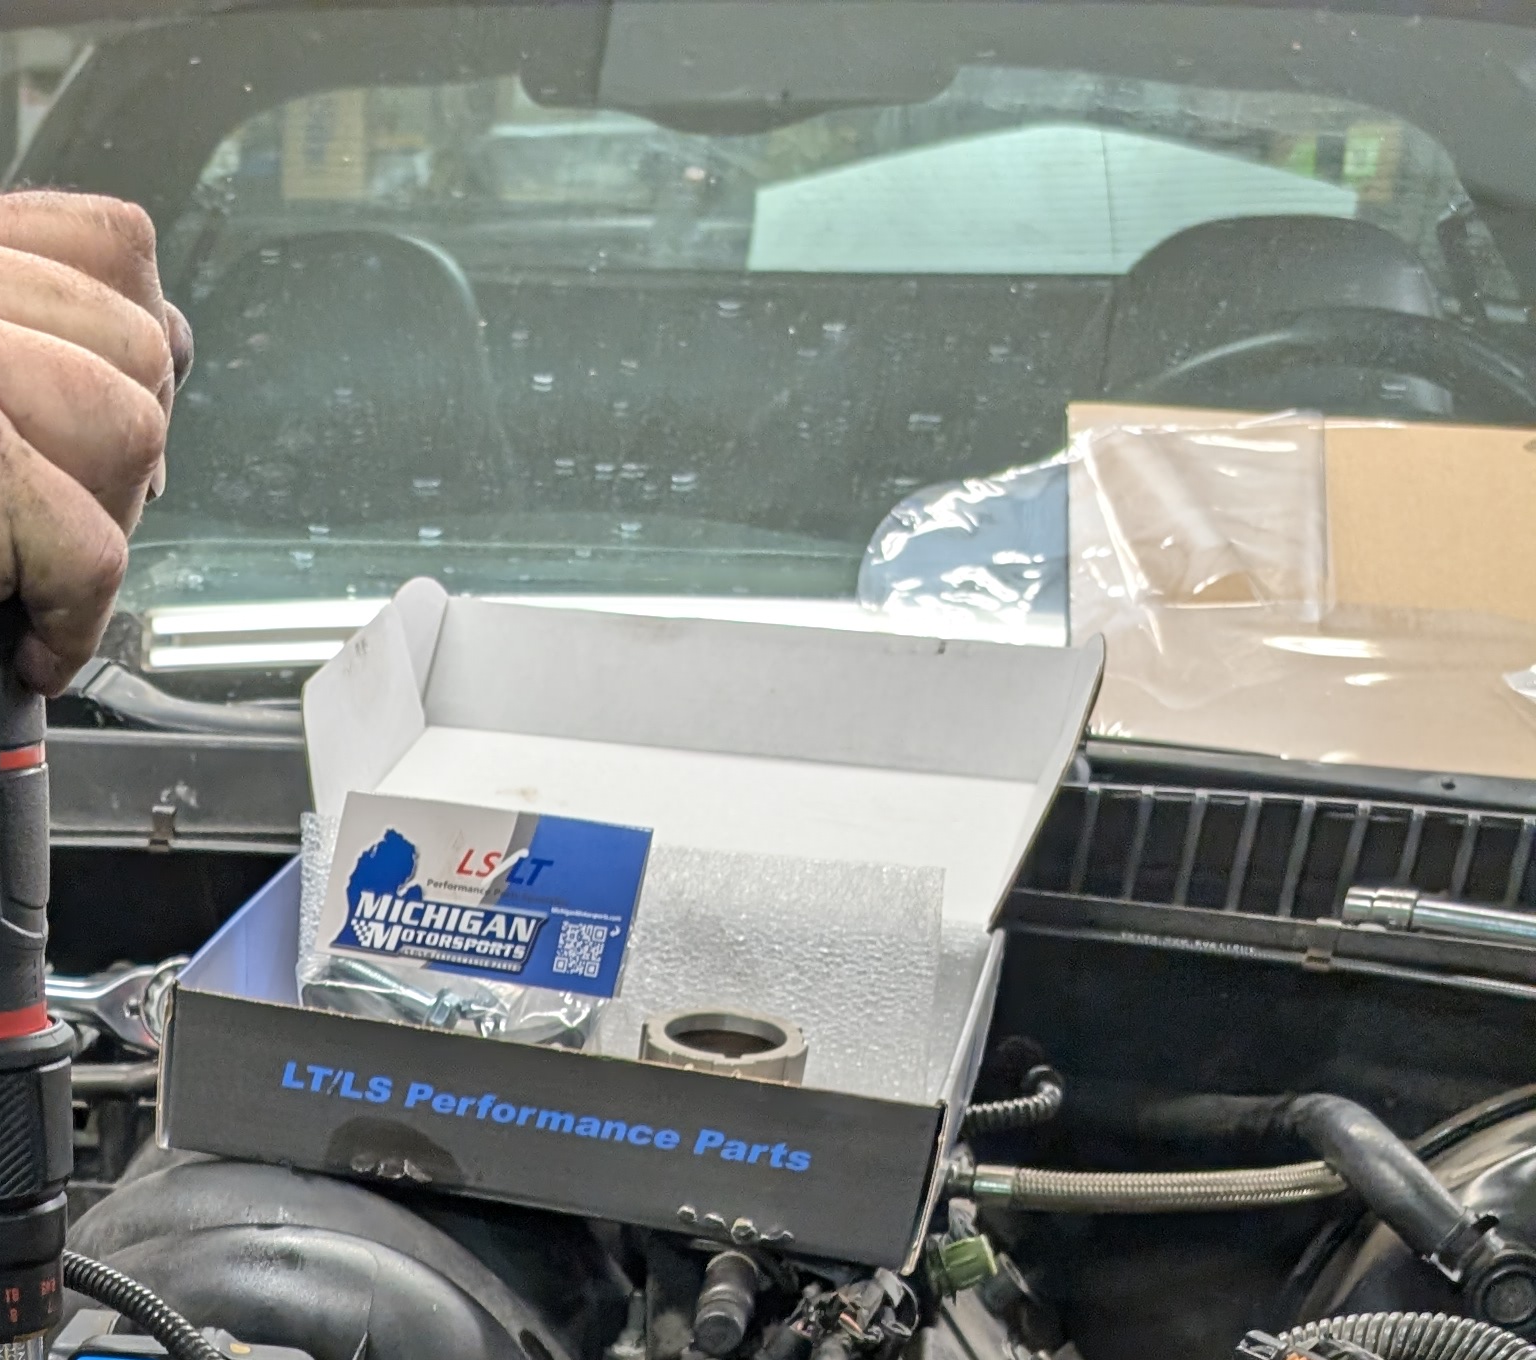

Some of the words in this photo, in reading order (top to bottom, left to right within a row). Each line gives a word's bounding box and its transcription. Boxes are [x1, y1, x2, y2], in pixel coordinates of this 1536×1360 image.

[427, 878, 493, 897] Performance
[355, 890, 536, 943] MICHIGAN
[362, 921, 526, 960] MOTORSPORTS
[281, 1061, 392, 1104] LT/LS
[405, 1082, 680, 1151] Performance
[693, 1128, 812, 1173] Parts
